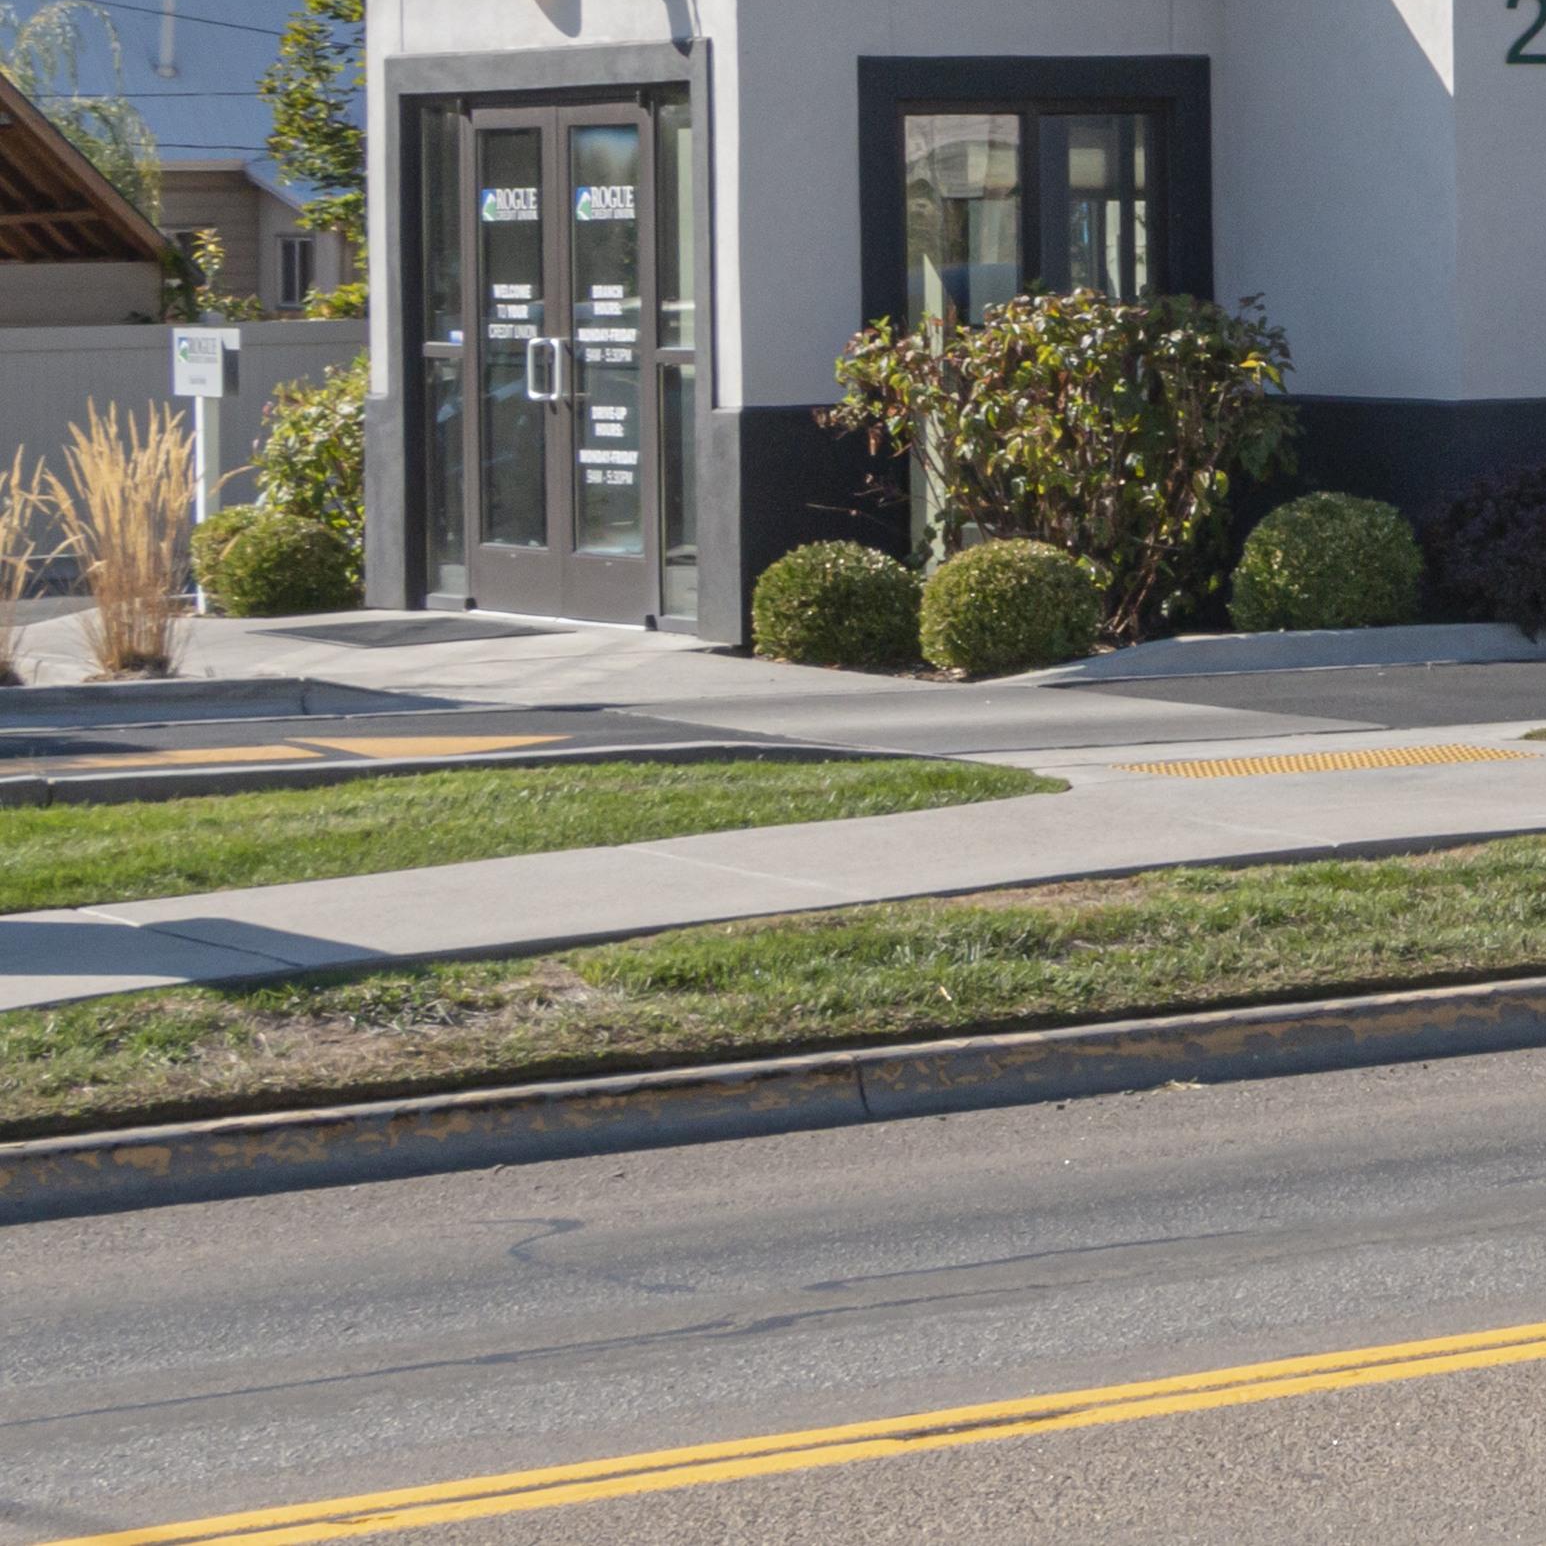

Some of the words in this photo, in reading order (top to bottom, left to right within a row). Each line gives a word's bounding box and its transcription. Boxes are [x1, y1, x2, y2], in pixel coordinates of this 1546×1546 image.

[495, 188, 538, 210] ROGUE
[590, 186, 635, 208] ROGUE
[492, 284, 533, 299] WELCOME
[507, 304, 529, 319] YOUR
